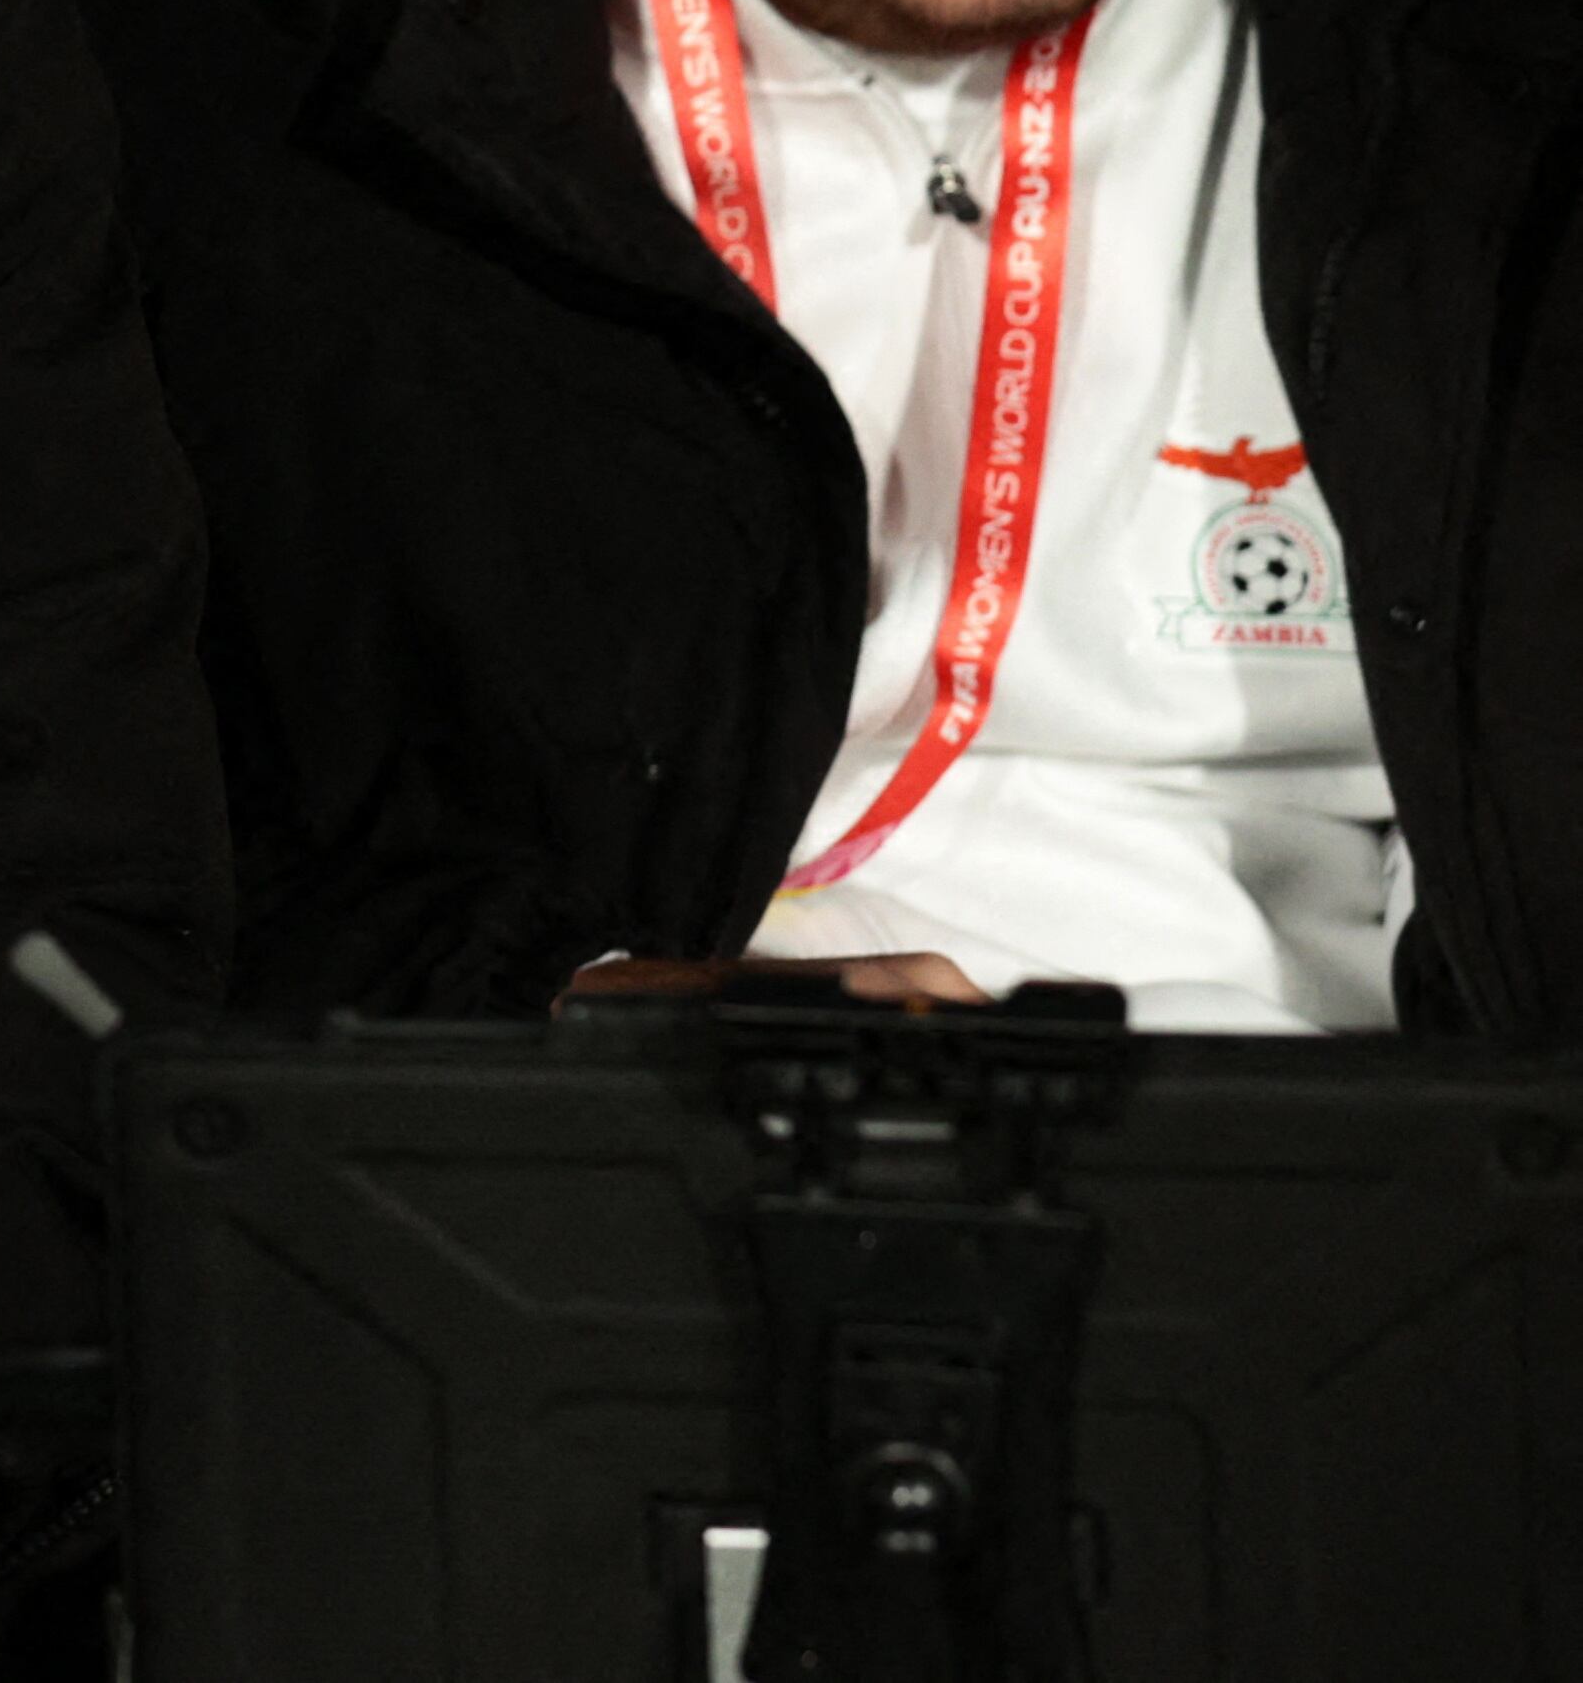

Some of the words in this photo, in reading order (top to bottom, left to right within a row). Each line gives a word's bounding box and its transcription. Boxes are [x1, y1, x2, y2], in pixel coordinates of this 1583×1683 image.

[689, 93, 749, 240] WORLD
[1002, 240, 1044, 327] CUP
[987, 327, 1037, 466] WORLD
[953, 469, 1022, 659] WOMEN'S
[939, 661, 980, 746] FIFA
